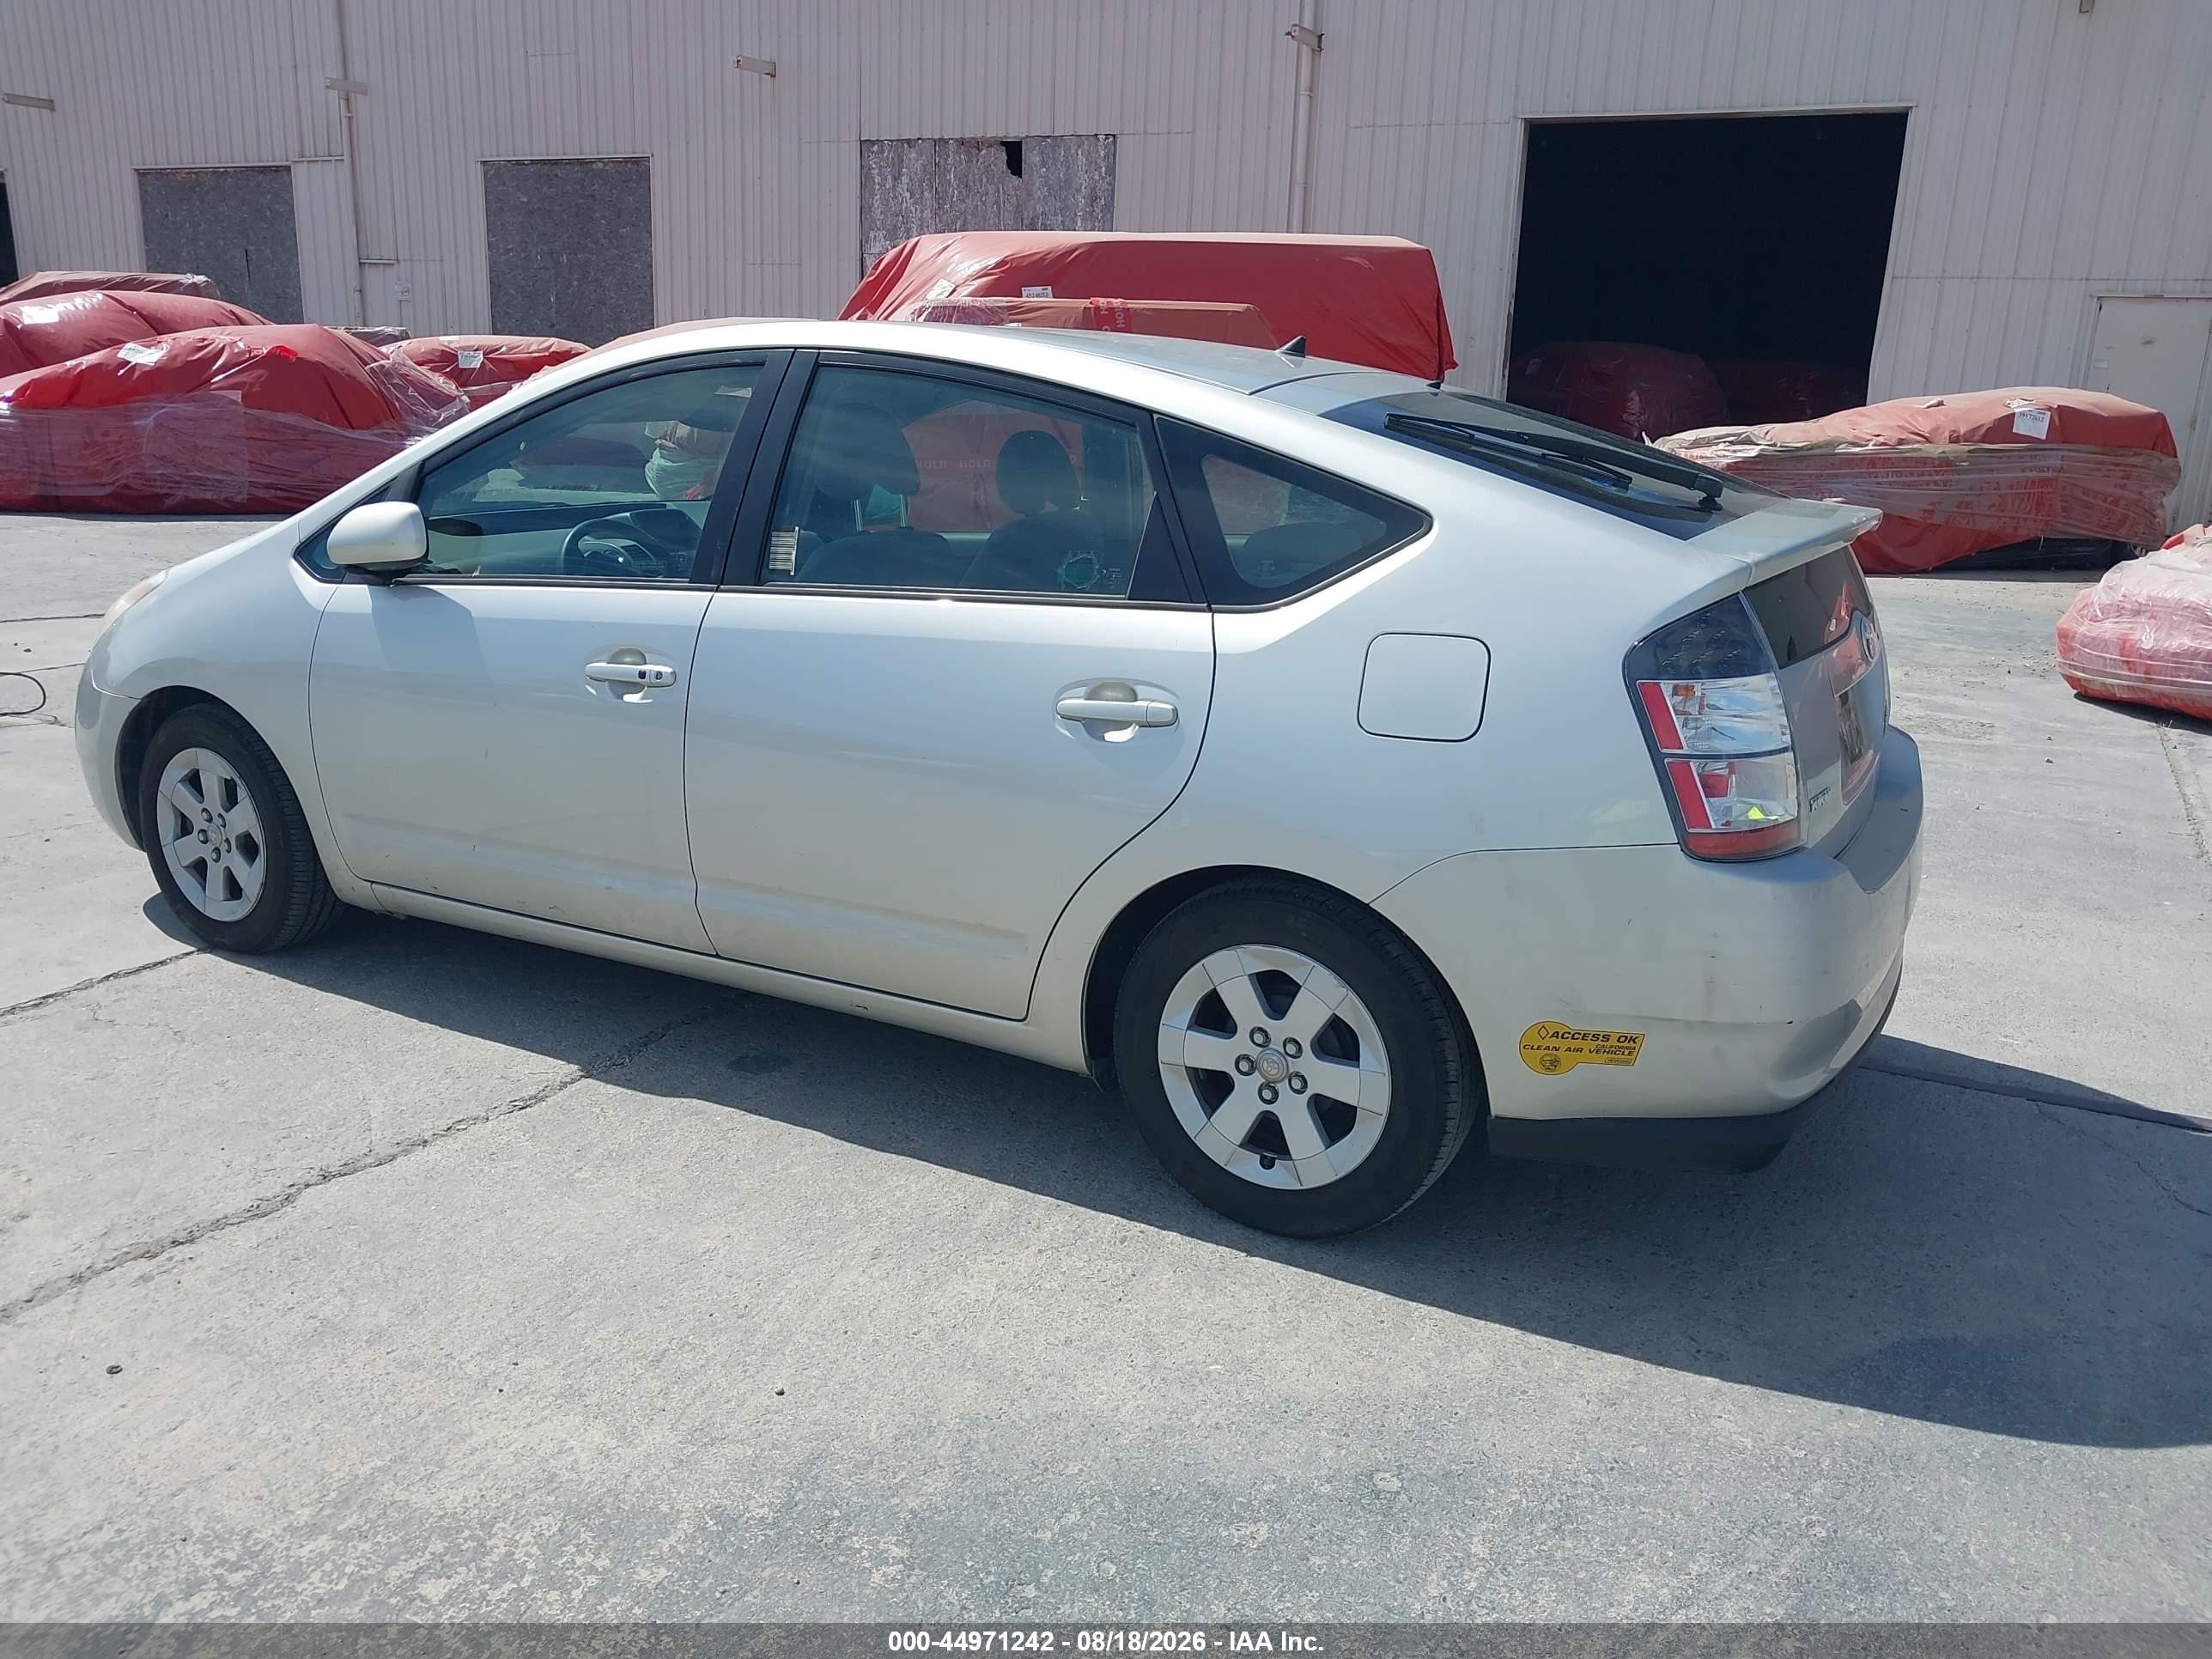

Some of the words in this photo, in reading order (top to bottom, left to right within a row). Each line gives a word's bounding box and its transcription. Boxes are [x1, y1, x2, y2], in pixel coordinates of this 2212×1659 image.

[959, 459, 991, 469] HOLD
[1548, 1030, 1611, 1042] ACCESS
[1616, 1035, 1640, 1044] OK
[1522, 1043, 1561, 1052] CLEAN
[1589, 1048, 1636, 1057] VEHICLE
